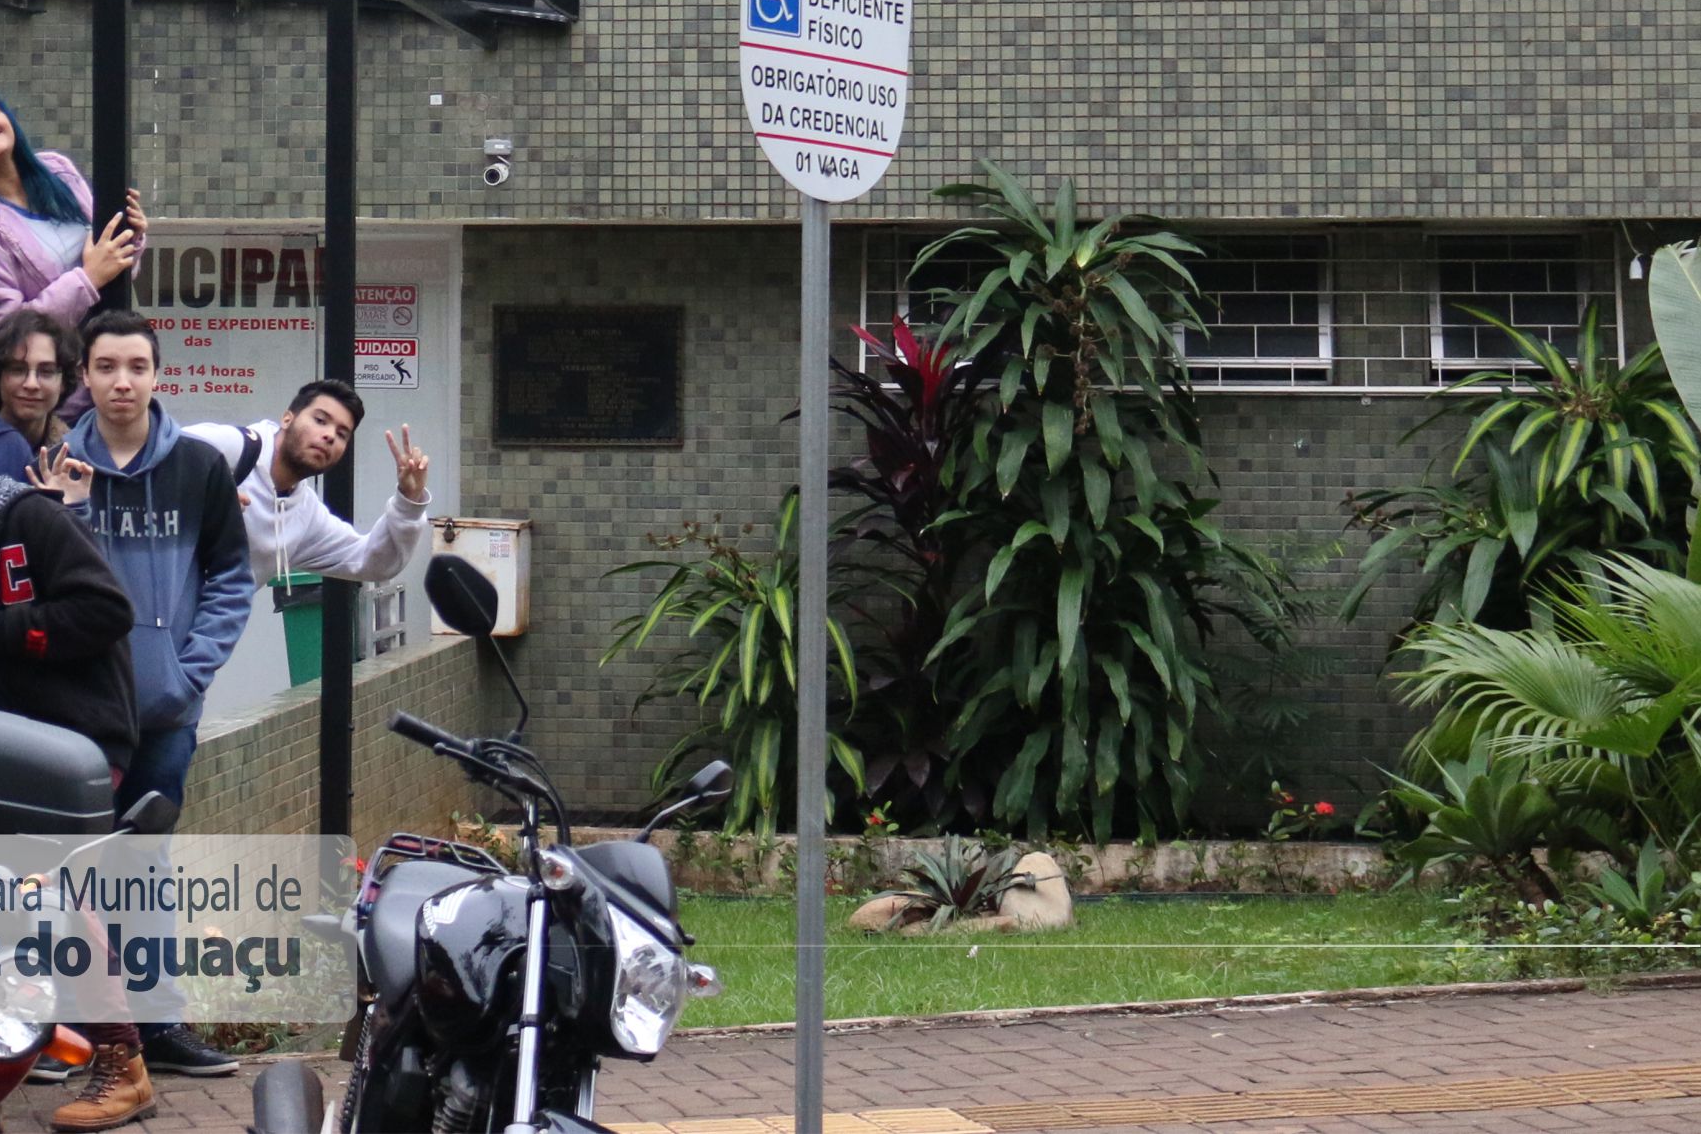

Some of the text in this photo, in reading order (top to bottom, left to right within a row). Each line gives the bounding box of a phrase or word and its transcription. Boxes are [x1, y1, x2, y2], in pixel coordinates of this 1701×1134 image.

[808, 16, 863, 50] FÍSICO
[868, 83, 898, 109] USO
[762, 102, 889, 143] DA CREDENCIAL
[796, 151, 861, 181] 01 VAGA
[181, 318, 202, 331] DE
[207, 318, 316, 331] EXPEDIENTE:
[183, 334, 212, 347] das
[354, 342, 412, 355] CUIDADO
[188, 365, 206, 377] 14
[211, 364, 256, 378] horas
[364, 364, 380, 372] PISO
[189, 383, 199, 394] a
[203, 382, 254, 395] Sexta.
